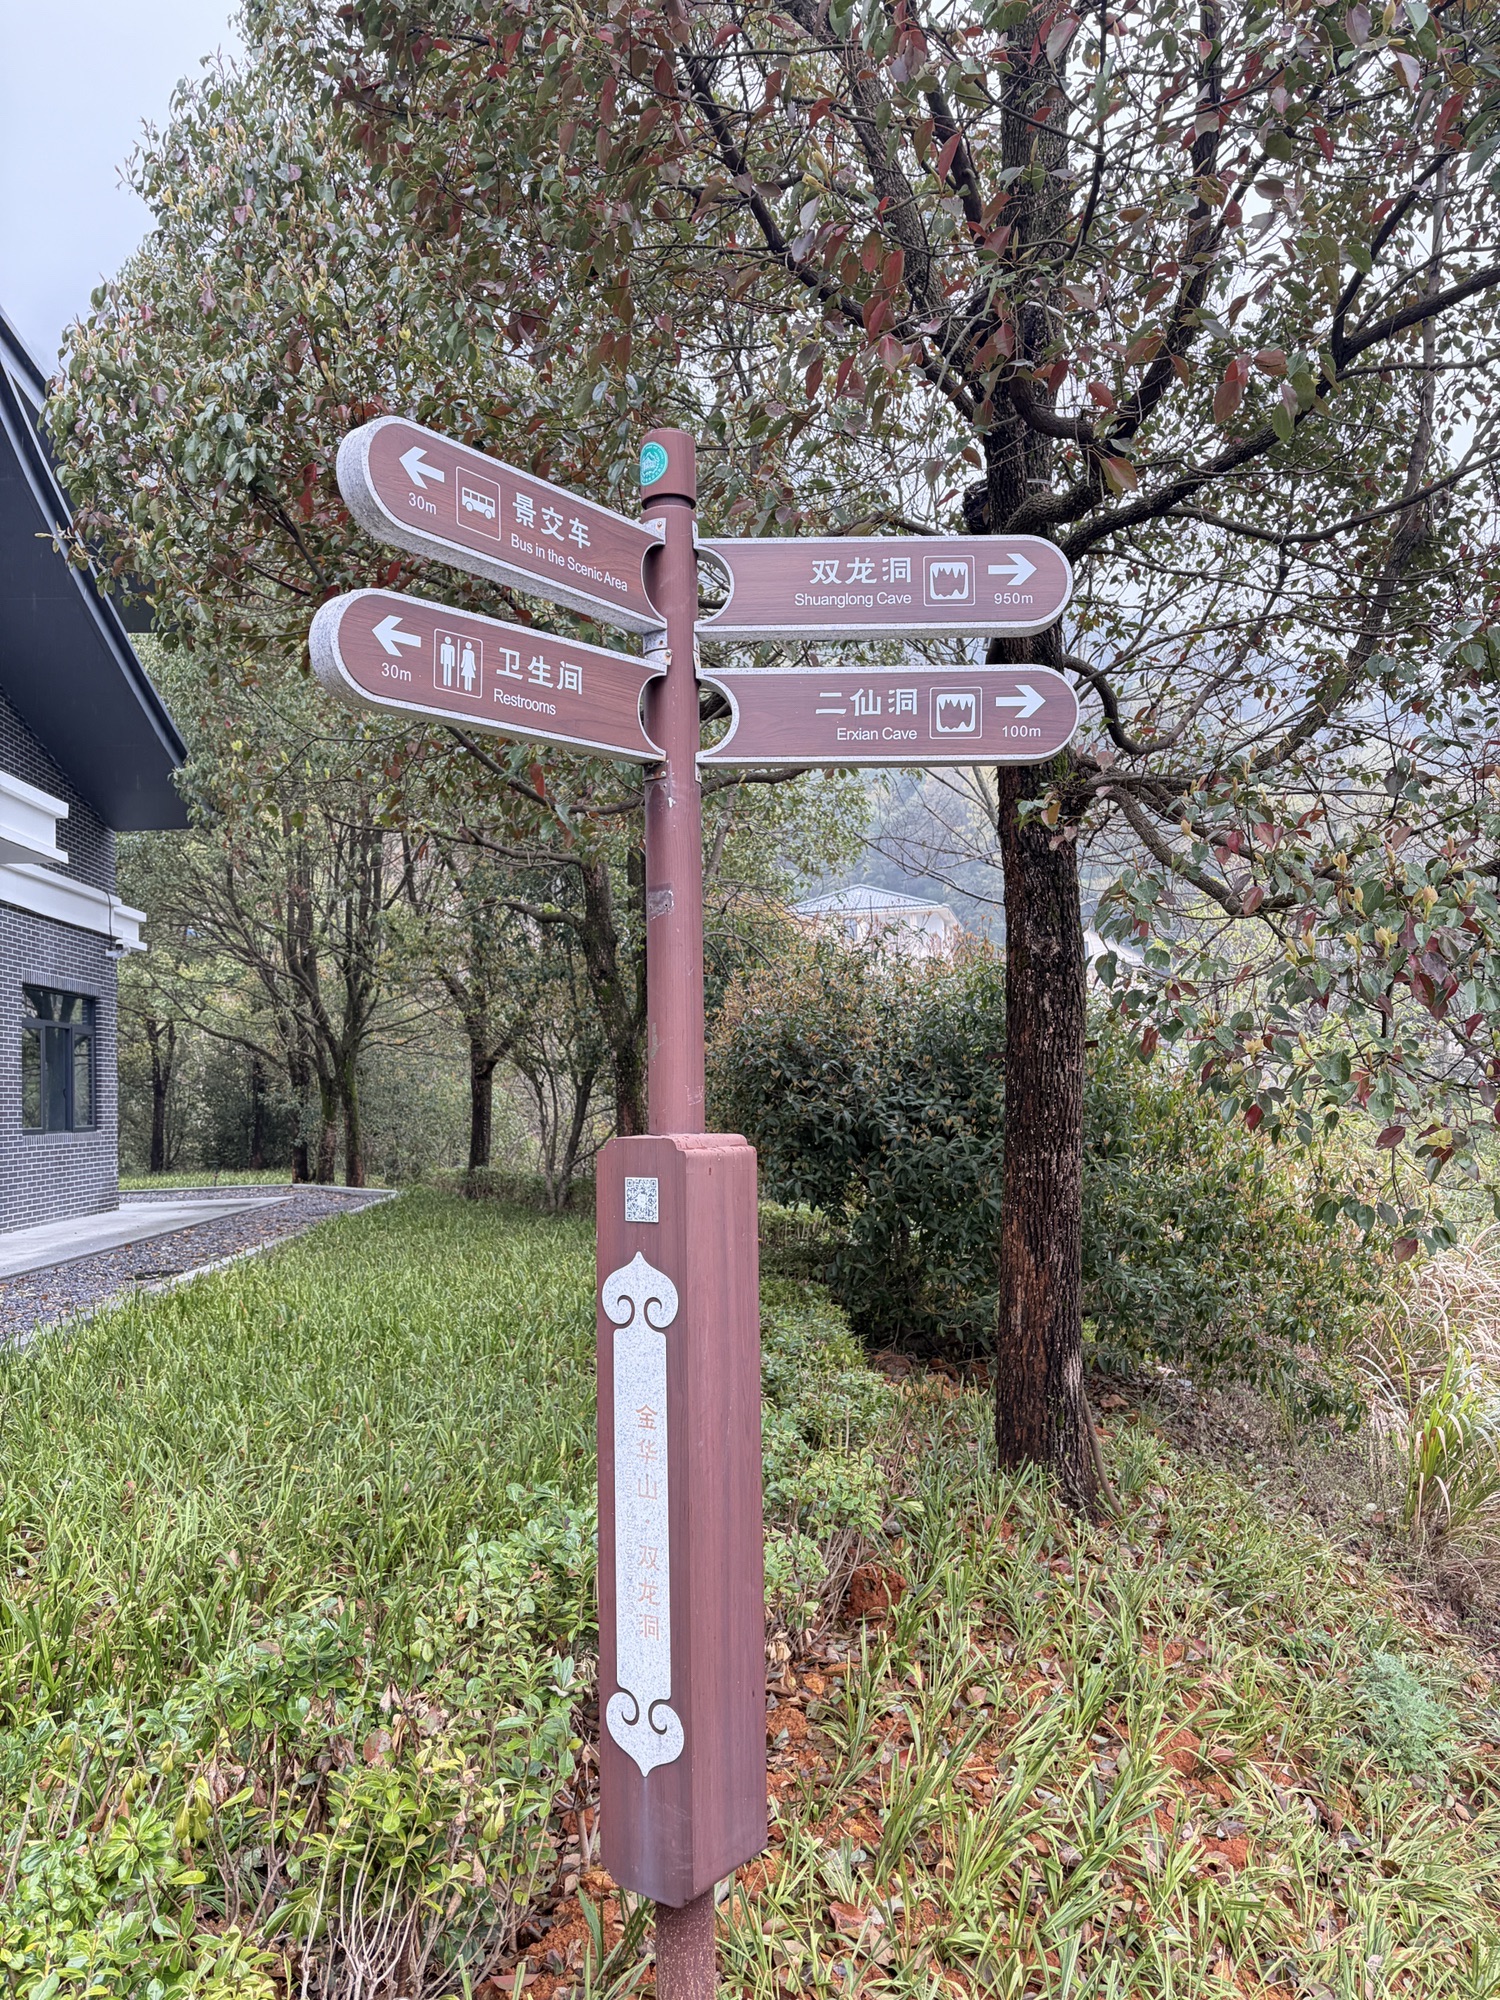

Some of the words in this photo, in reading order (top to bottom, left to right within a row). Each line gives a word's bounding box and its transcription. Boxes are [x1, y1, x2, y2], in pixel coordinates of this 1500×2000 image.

[408, 492, 437, 515] 30m
[512, 492, 591, 549] 景交车
[511, 533, 533, 554] Bus
[535, 543, 545, 559] in
[548, 548, 565, 567] the
[567, 556, 603, 582] Scenic
[603, 572, 628, 592] Area
[809, 556, 912, 585] 双龙洞
[794, 592, 873, 609] Shuanglong
[877, 591, 912, 605] Cave
[993, 592, 1034, 605] 950m
[381, 662, 412, 682] 30m
[496, 647, 583, 695] 卫生间
[493, 688, 557, 716] Restrooms
[815, 687, 918, 717] 二仙洞
[836, 727, 879, 741] Erxian
[882, 727, 918, 741] Cave
[1001, 725, 1041, 738] 100m
